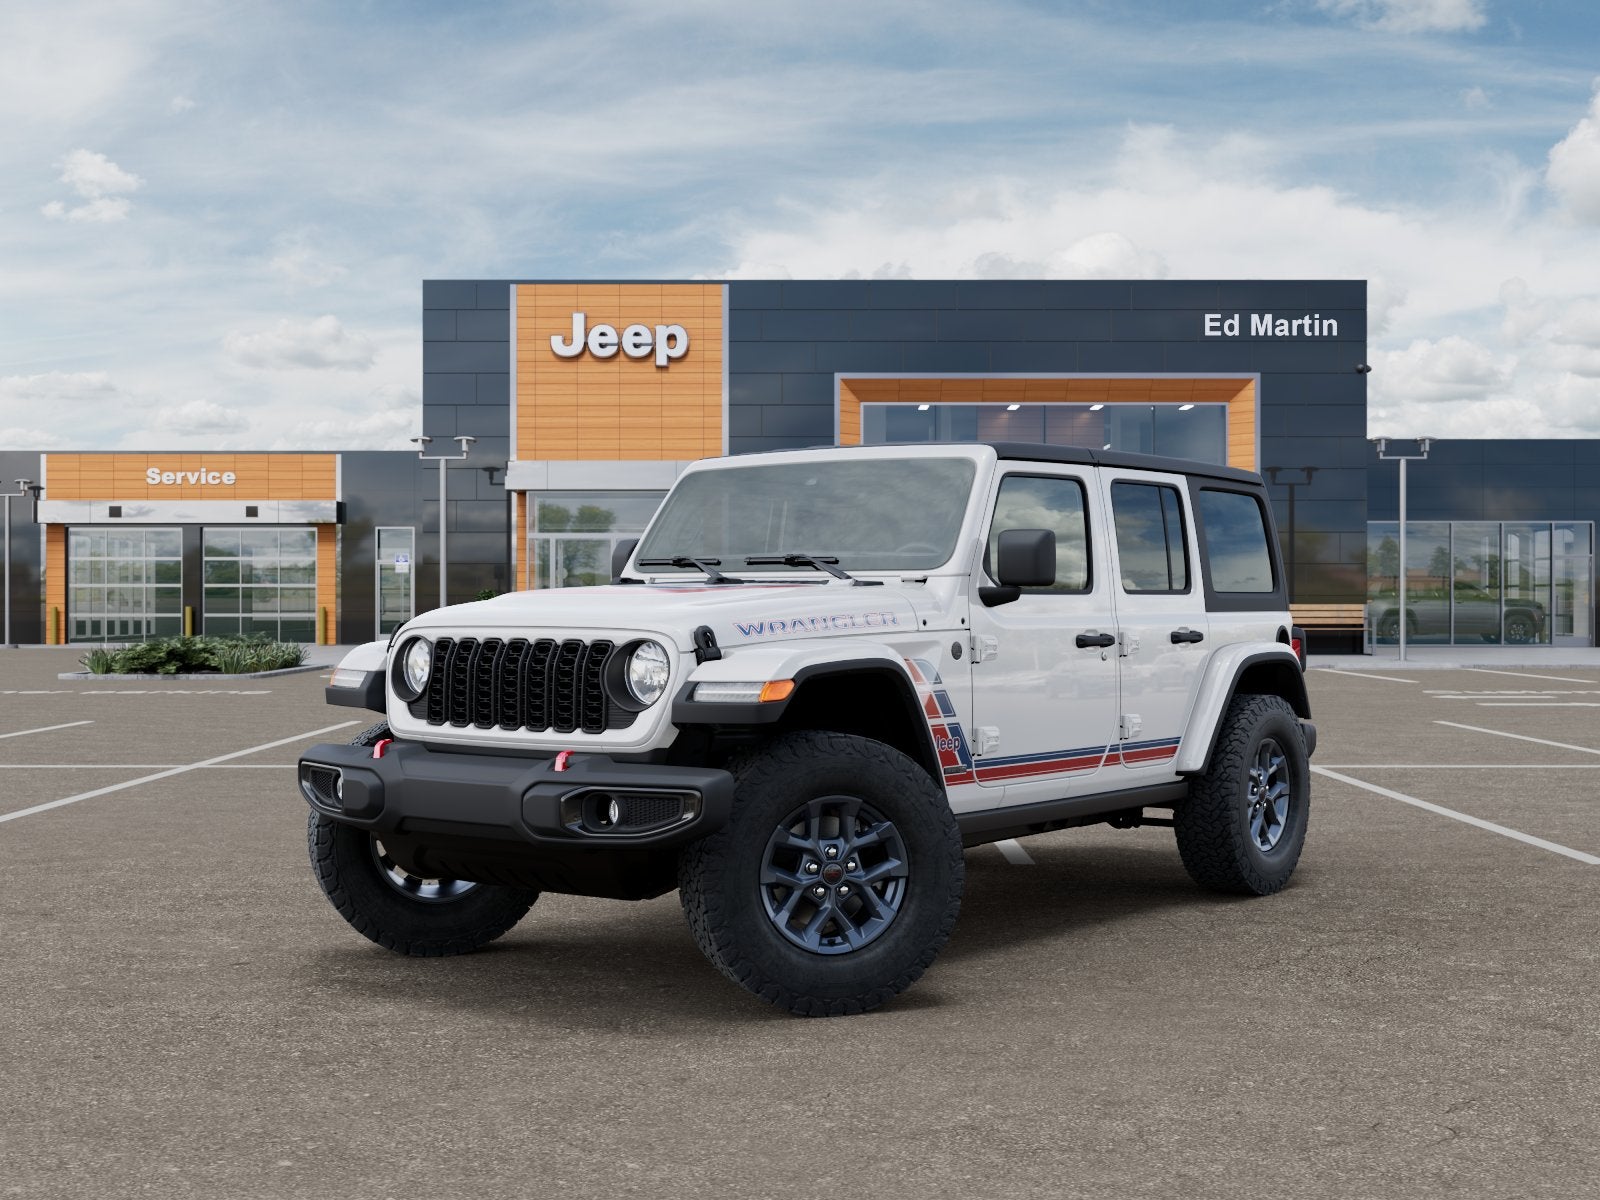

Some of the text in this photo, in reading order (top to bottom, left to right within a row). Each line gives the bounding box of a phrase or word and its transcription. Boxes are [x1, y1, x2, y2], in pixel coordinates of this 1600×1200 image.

[1204, 313, 1338, 337] Ed Martin
[550, 312, 689, 367] Jeep
[146, 467, 236, 485] Service
[734, 612, 899, 636] WRANGLER
